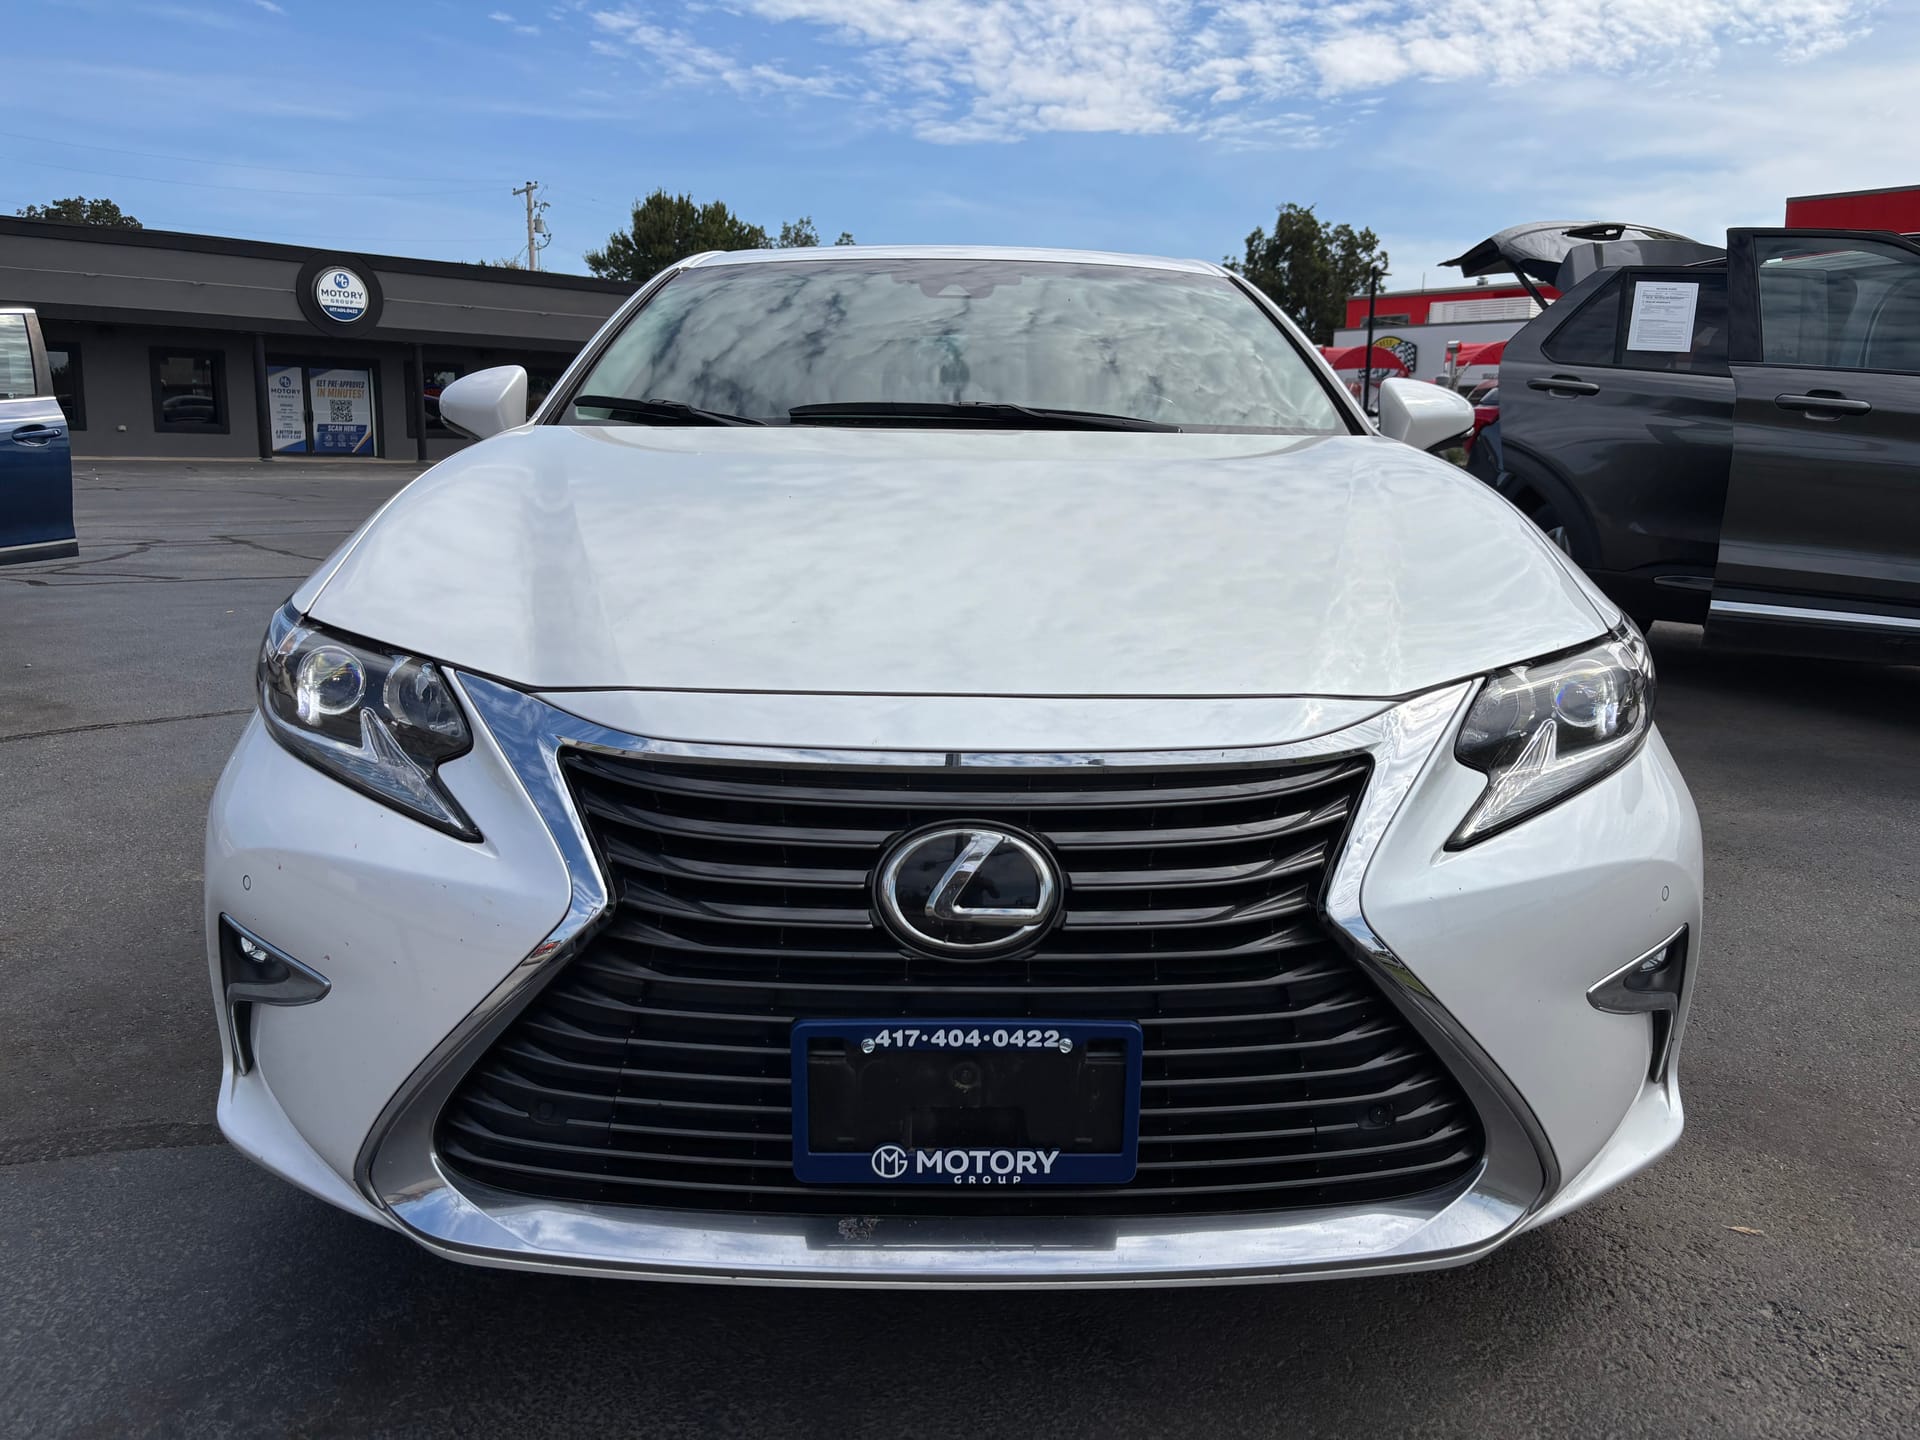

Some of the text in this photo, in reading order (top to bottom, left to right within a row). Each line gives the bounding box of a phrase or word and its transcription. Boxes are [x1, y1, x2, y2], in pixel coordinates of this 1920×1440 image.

[321, 289, 364, 300] MOTORY
[316, 379, 365, 389] GET PRE-APPROVED
[317, 388, 365, 399] IN MINUTES!
[916, 1150, 1060, 1174] MOTORY
[953, 1175, 1022, 1184] GROUP
